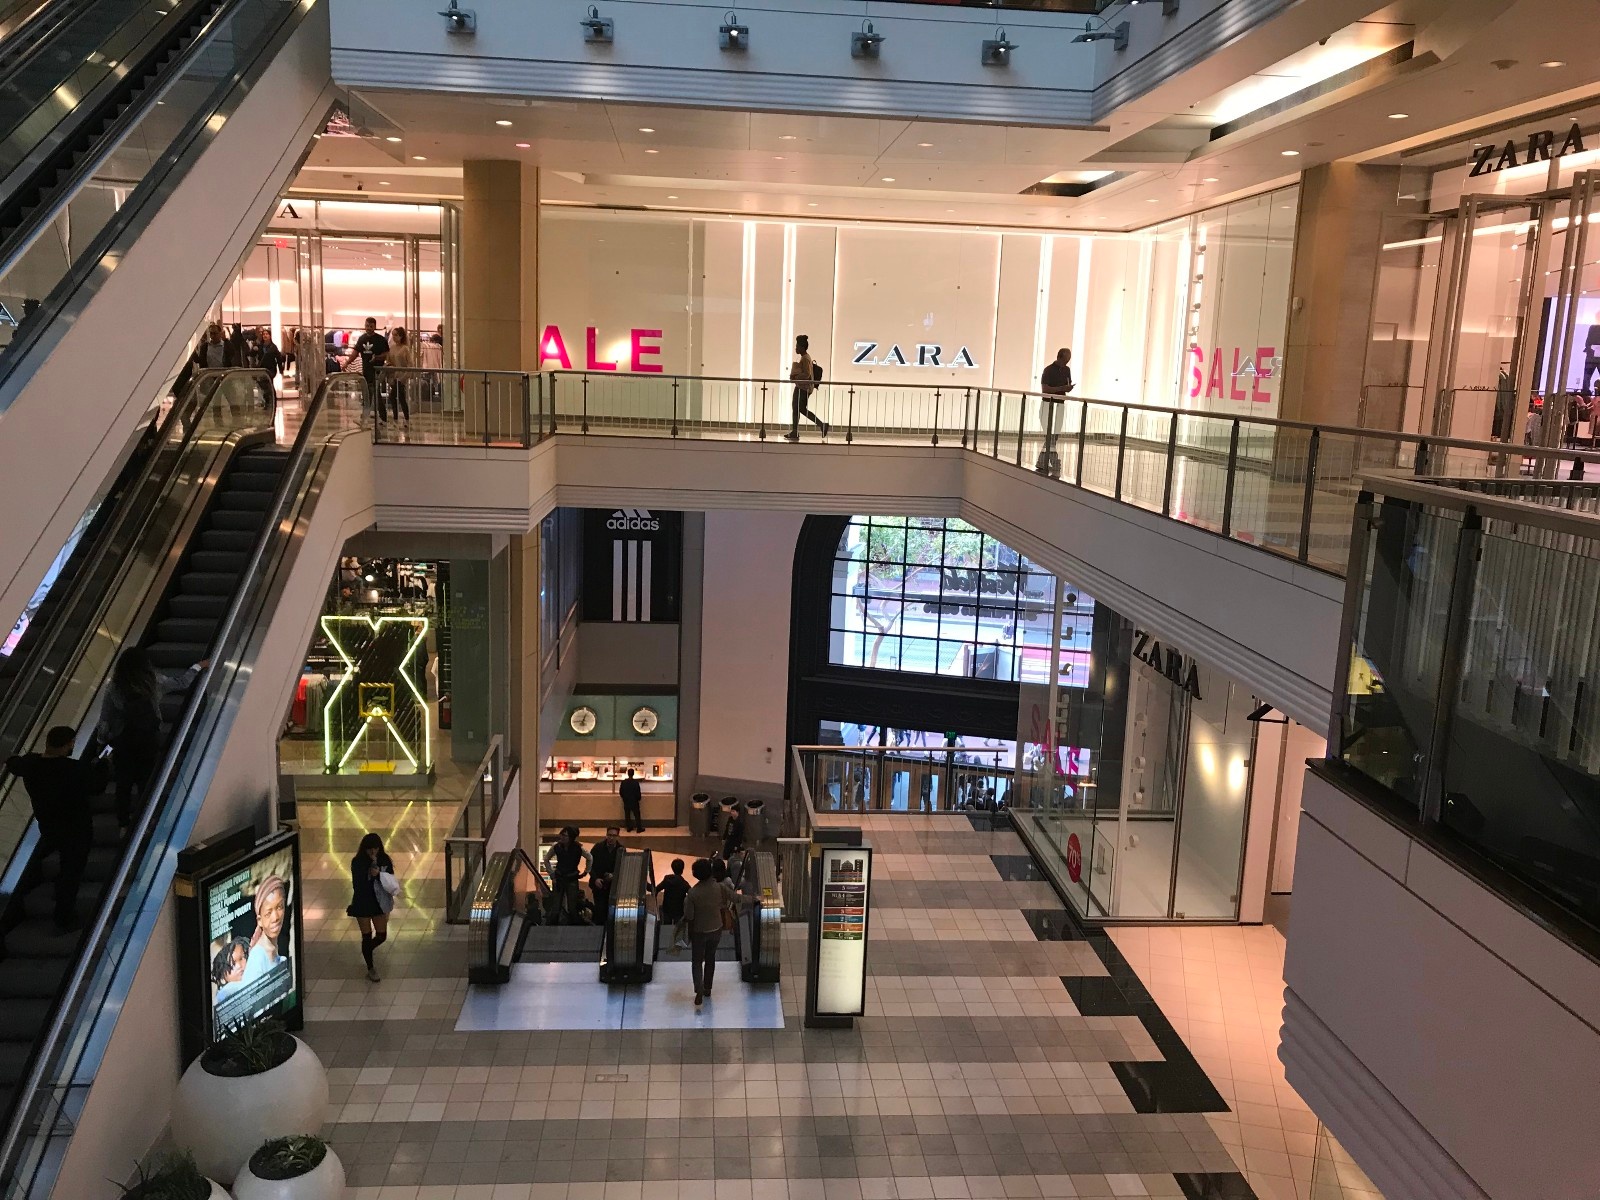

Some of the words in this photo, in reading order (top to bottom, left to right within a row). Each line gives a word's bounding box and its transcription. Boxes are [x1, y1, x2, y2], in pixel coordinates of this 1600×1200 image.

[1468, 123, 1588, 177] ZARA
[852, 342, 979, 369] ZARA
[1187, 346, 1275, 403] SALE
[606, 517, 660, 531] adidas
[1132, 629, 1202, 700] ZARA
